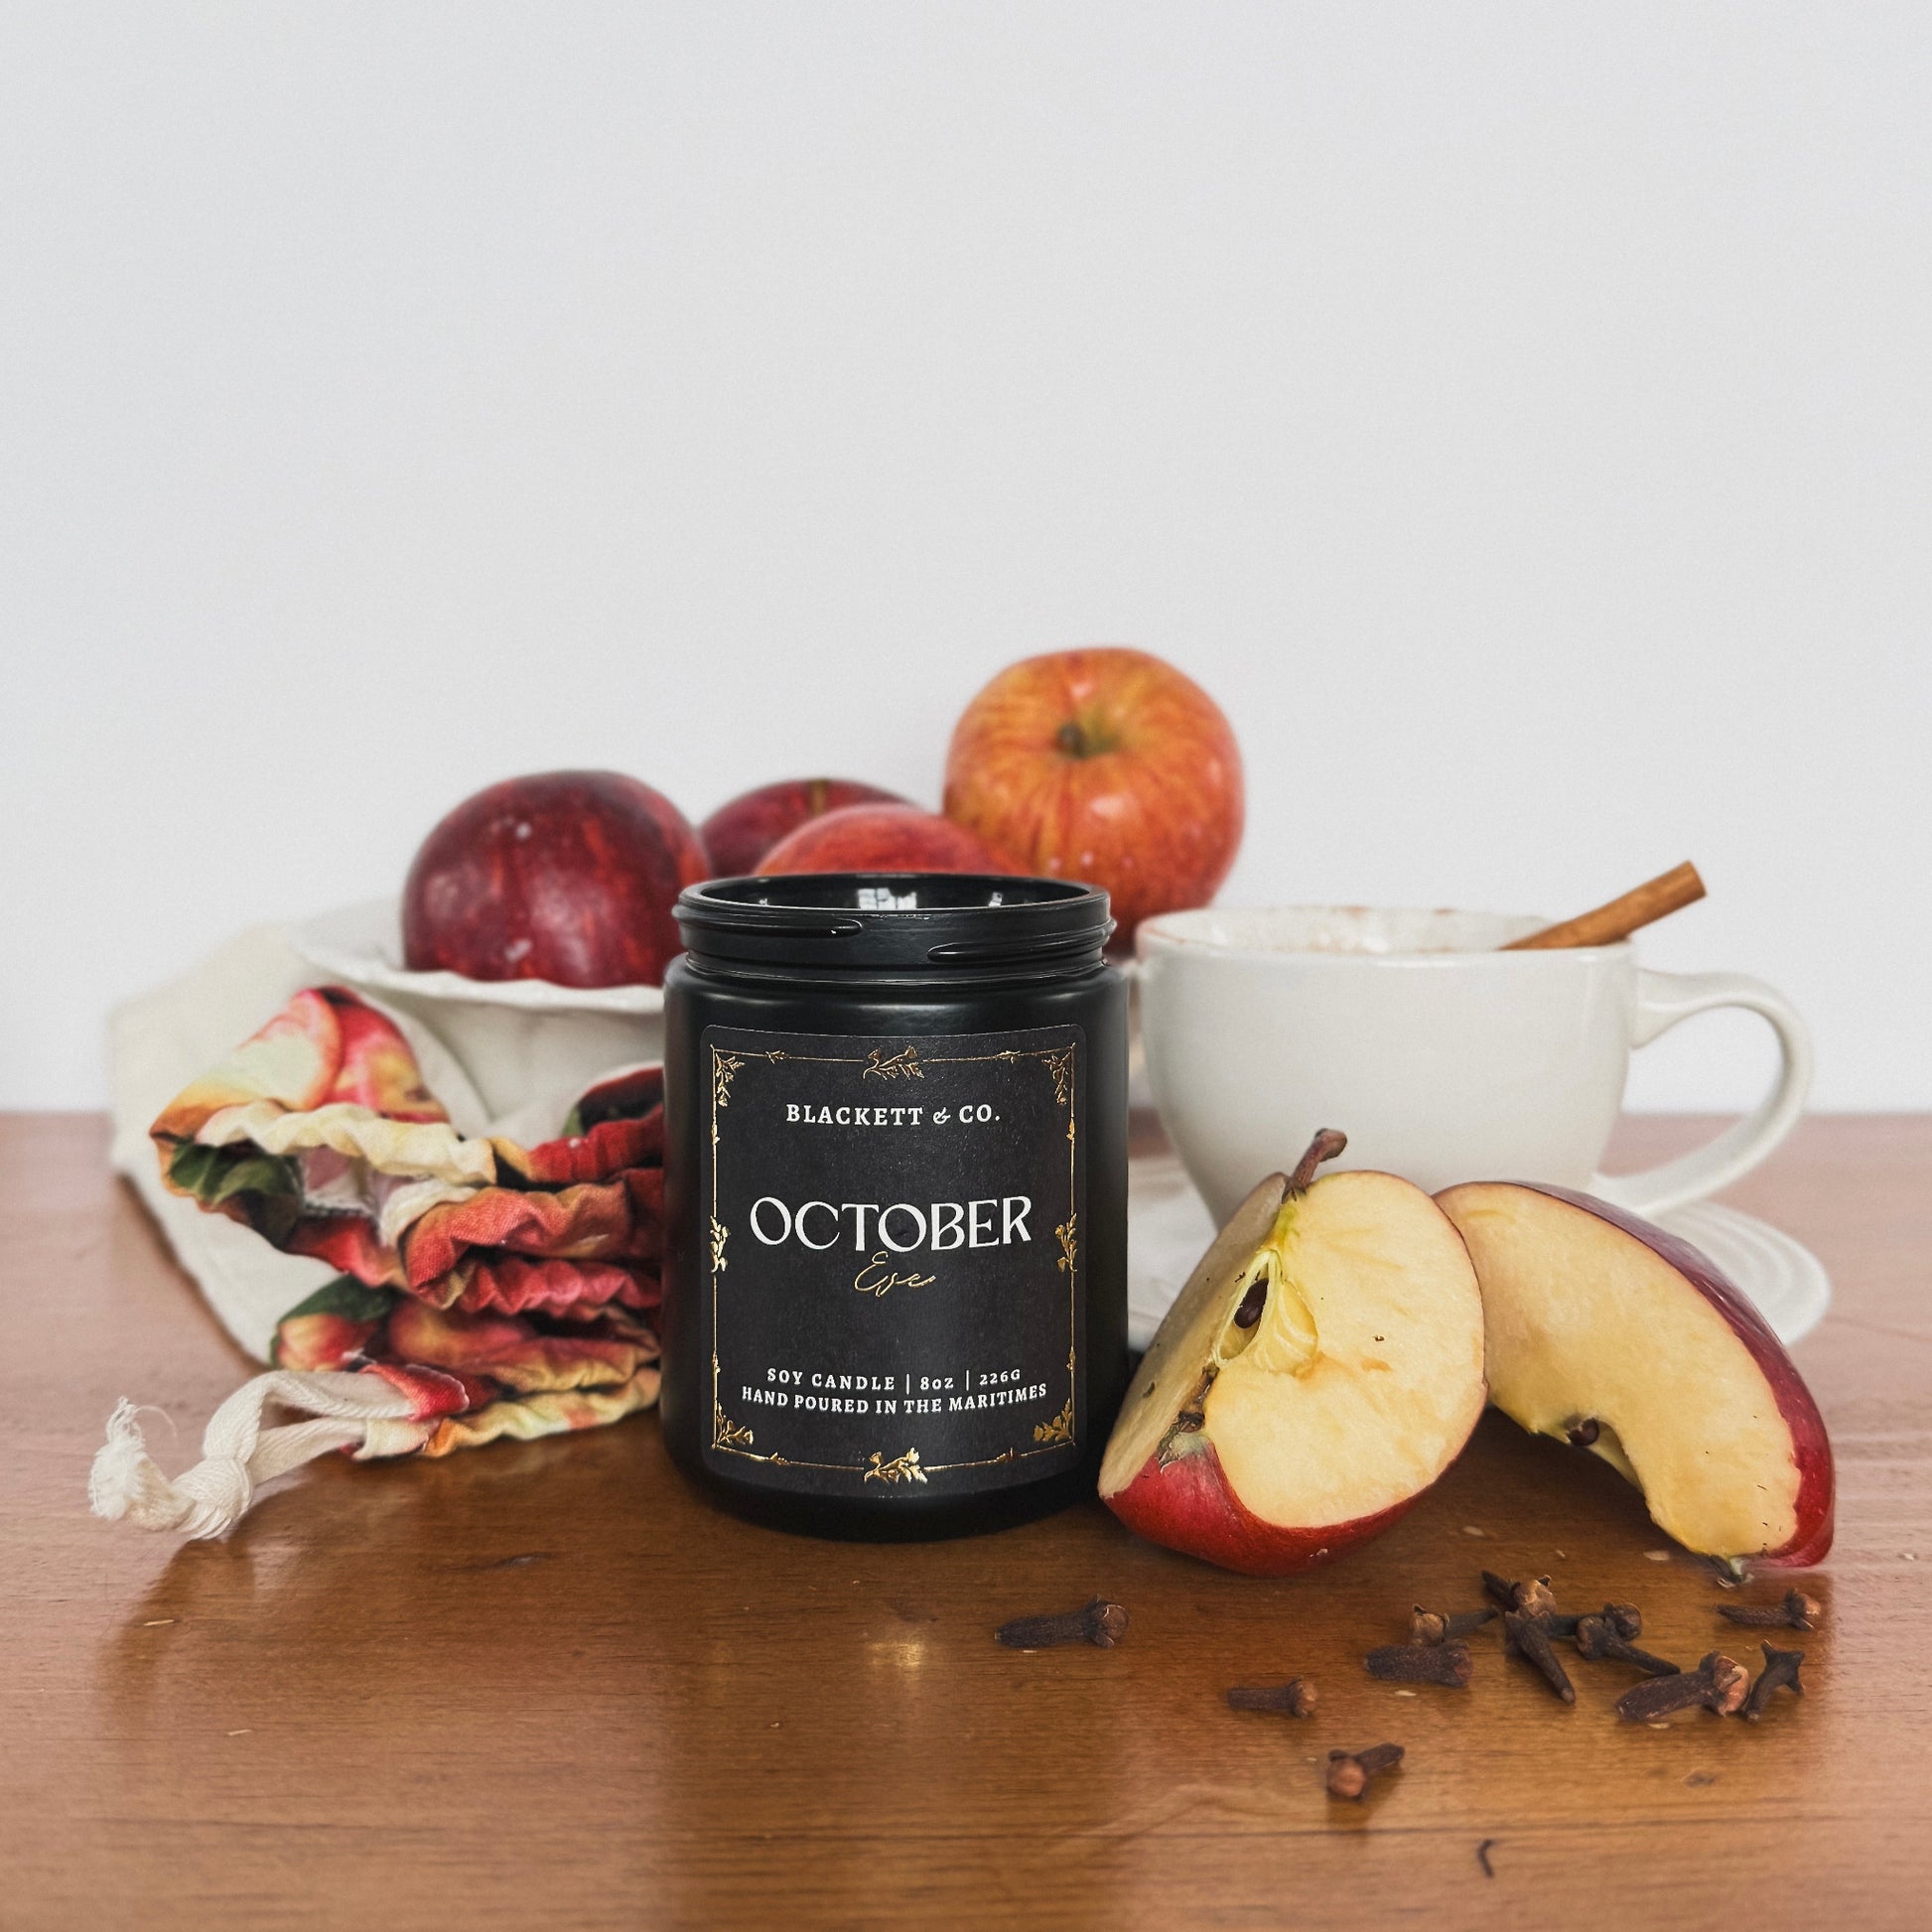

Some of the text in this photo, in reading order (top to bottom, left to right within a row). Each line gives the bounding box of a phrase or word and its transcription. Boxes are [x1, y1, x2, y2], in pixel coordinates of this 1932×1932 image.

[785, 1103, 1001, 1127] BLACKETT & CO.
[750, 1195, 1032, 1253] OCTOBER
[766, 1367, 803, 1386] SOY
[811, 1373, 895, 1391] CANDLE
[979, 1368, 1021, 1387] 226G
[742, 1382, 1047, 1415] HAND POURED IN THE MARITIMES
